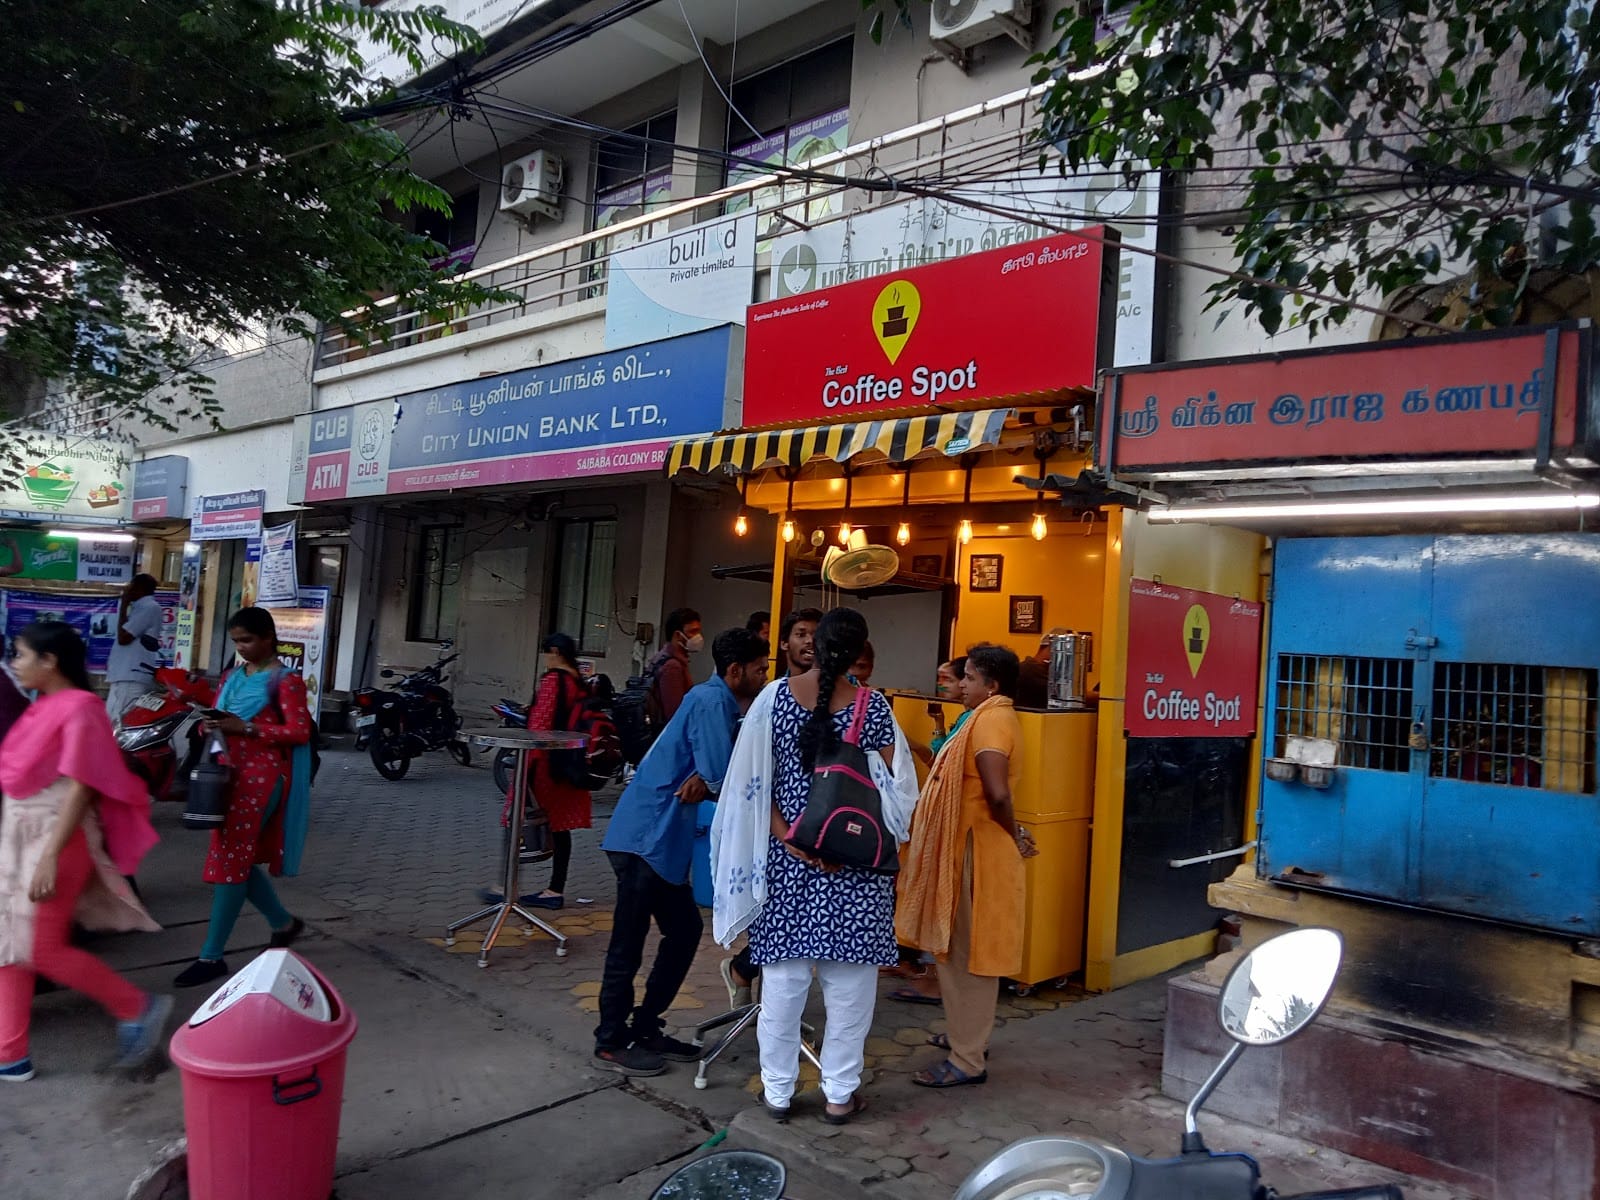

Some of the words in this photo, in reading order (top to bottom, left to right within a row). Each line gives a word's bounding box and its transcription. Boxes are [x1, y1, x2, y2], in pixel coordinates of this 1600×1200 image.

[670, 265, 700, 284] Private
[701, 255, 735, 275] Limited
[821, 372, 903, 408] Coffee
[910, 360, 978, 401] Spot
[825, 366, 836, 377] The
[425, 391, 464, 417] சிட்டி
[469, 372, 545, 418] யூனியன்
[549, 361, 606, 395] பாங்க்
[1268, 391, 1387, 430] இராஜ
[314, 415, 348, 442] CUB
[422, 432, 461, 454] CITY
[468, 422, 529, 448] UNION
[539, 412, 601, 439] BANK
[357, 461, 379, 477] CUB
[576, 454, 611, 471] SAIBABA
[612, 450, 649, 468] COLONY
[651, 448, 667, 465] BR
[311, 463, 343, 491] ATM
[32, 549, 69, 567] Sprite
[80, 552, 131, 566] PALAMUTHIR
[92, 541, 120, 553] SHREE
[87, 566, 122, 578] NILAYAM
[1143, 689, 1201, 721] Coffee
[1204, 692, 1241, 727] Spot
